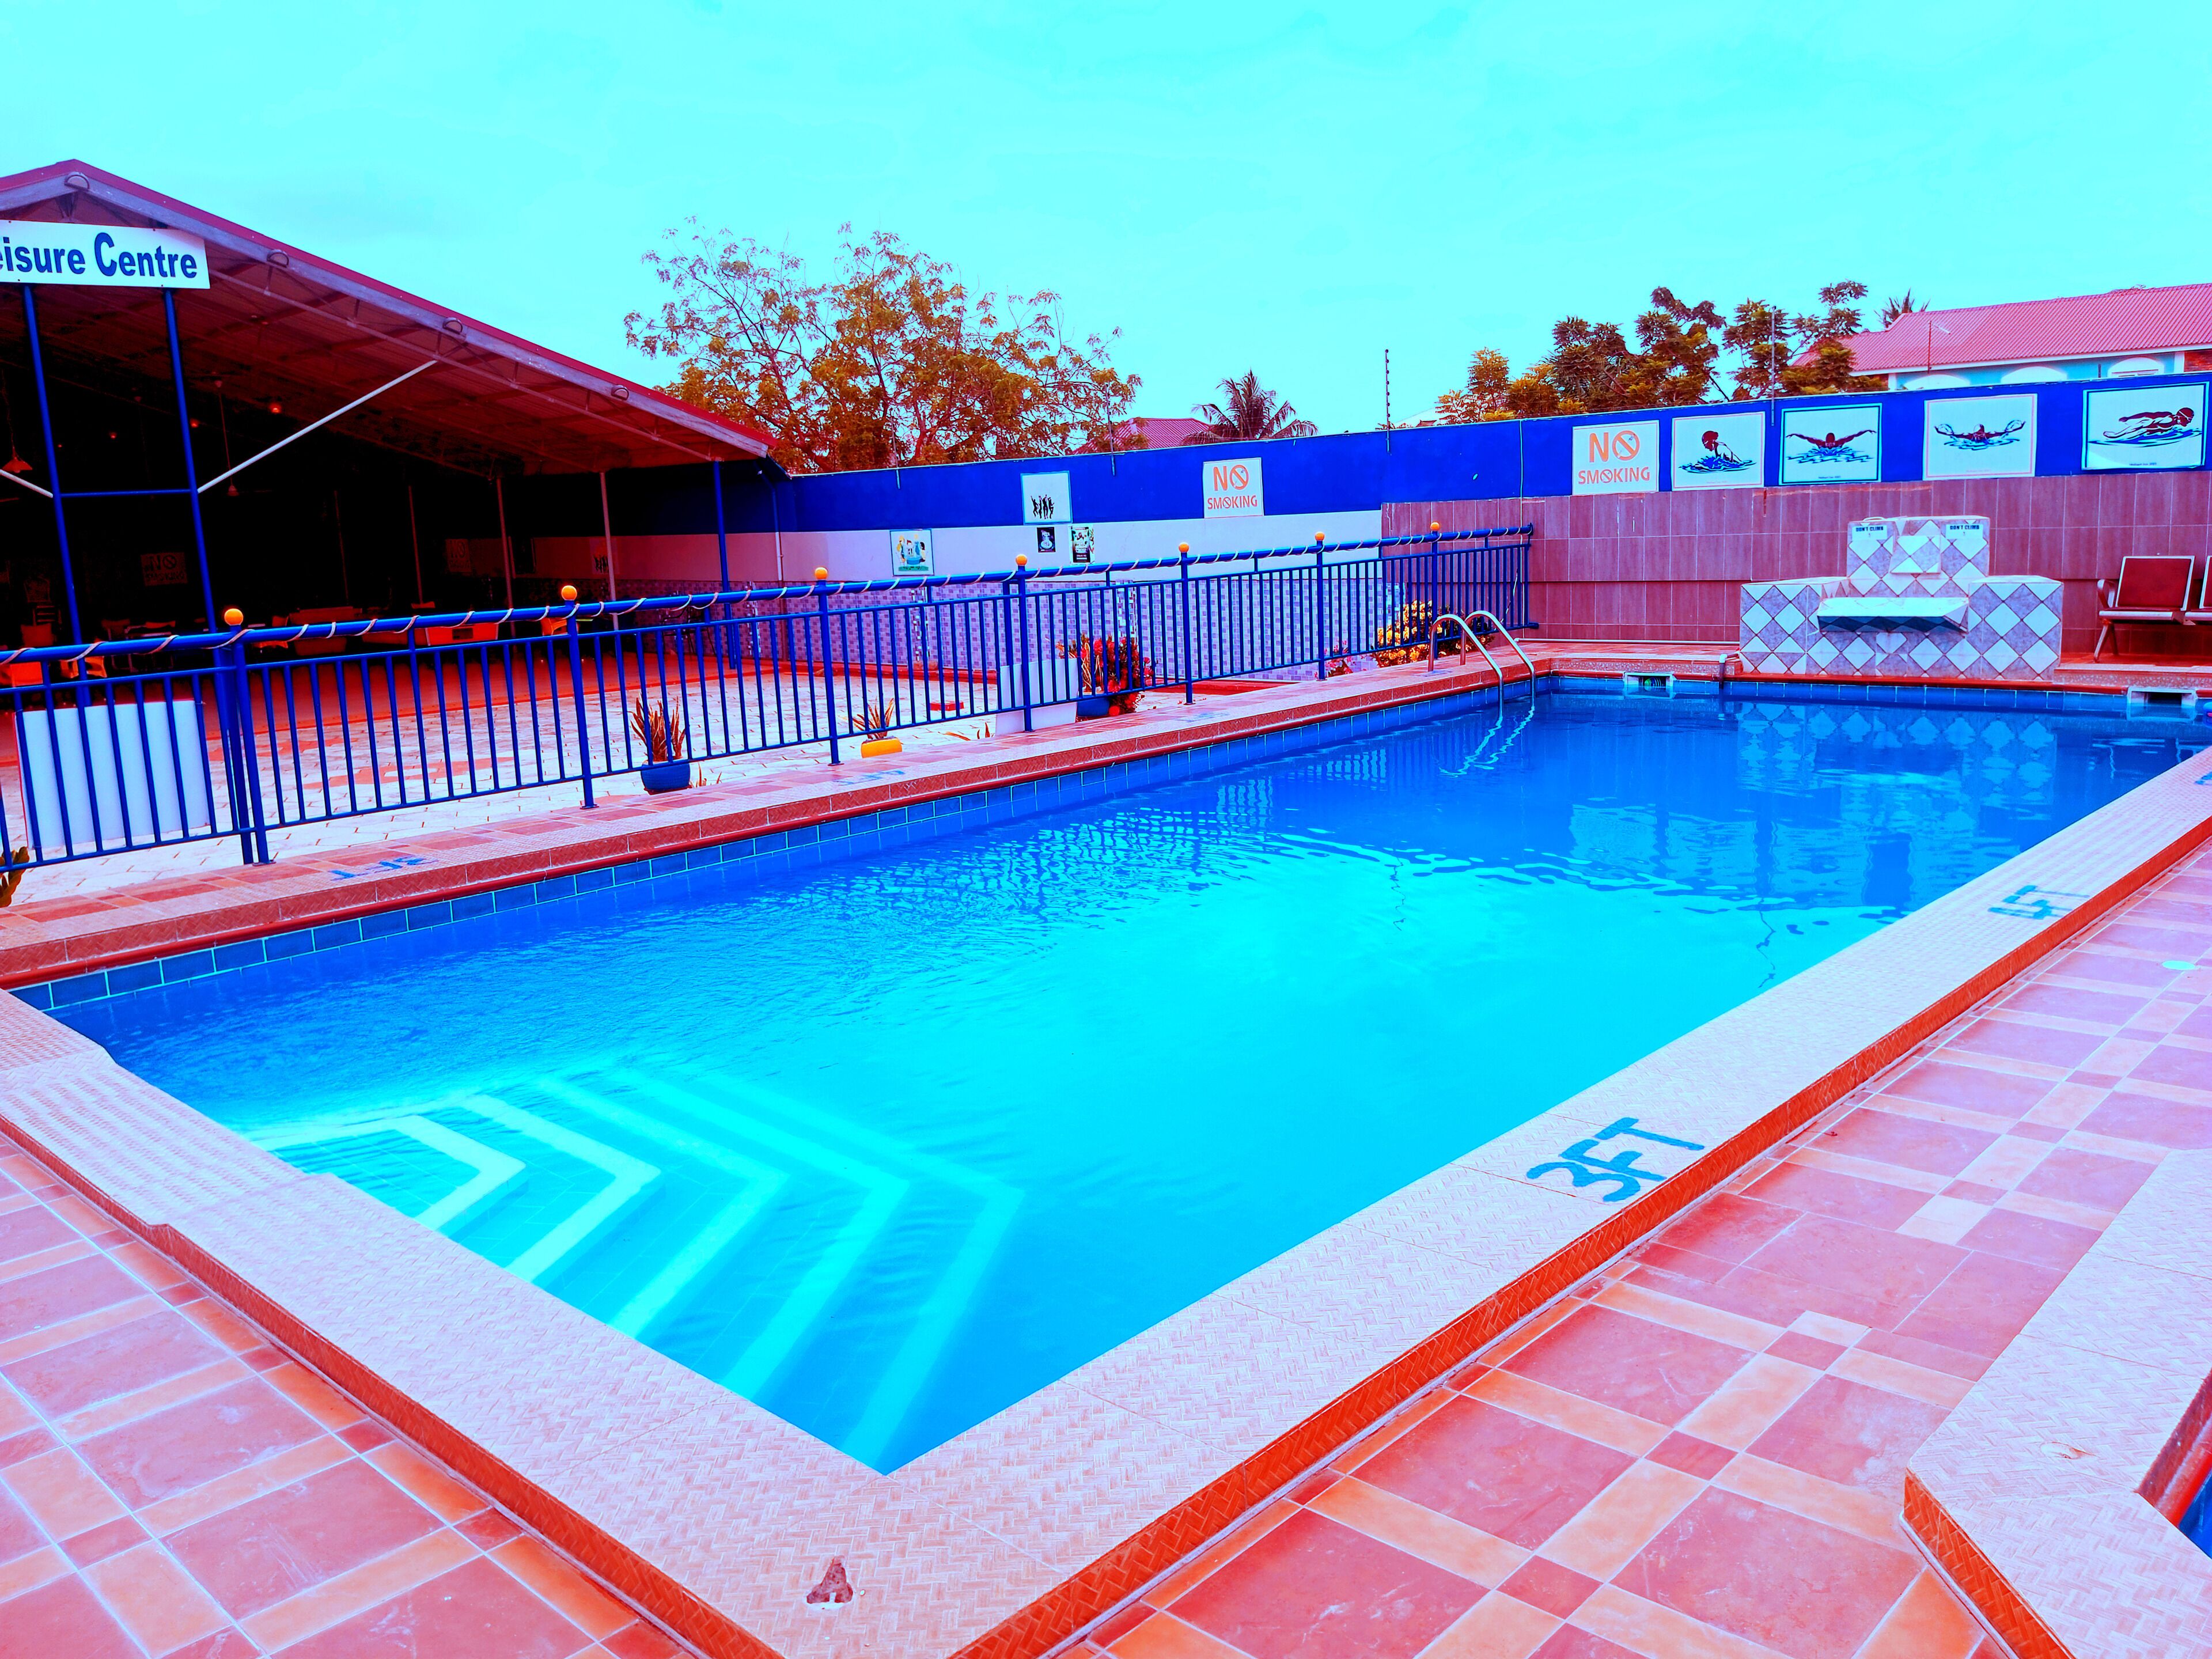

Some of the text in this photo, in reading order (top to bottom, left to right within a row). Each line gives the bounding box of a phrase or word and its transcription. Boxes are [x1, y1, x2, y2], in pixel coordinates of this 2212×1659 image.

[0, 232, 198, 279] isure Centre
[1589, 430, 1640, 463] NO
[1213, 464, 1249, 491] NO
[1578, 466, 1650, 484] SMOKING
[1207, 495, 1258, 510] SMOKING
[1987, 885, 2090, 920] 4FT
[1527, 1116, 1705, 1202] 3FT
